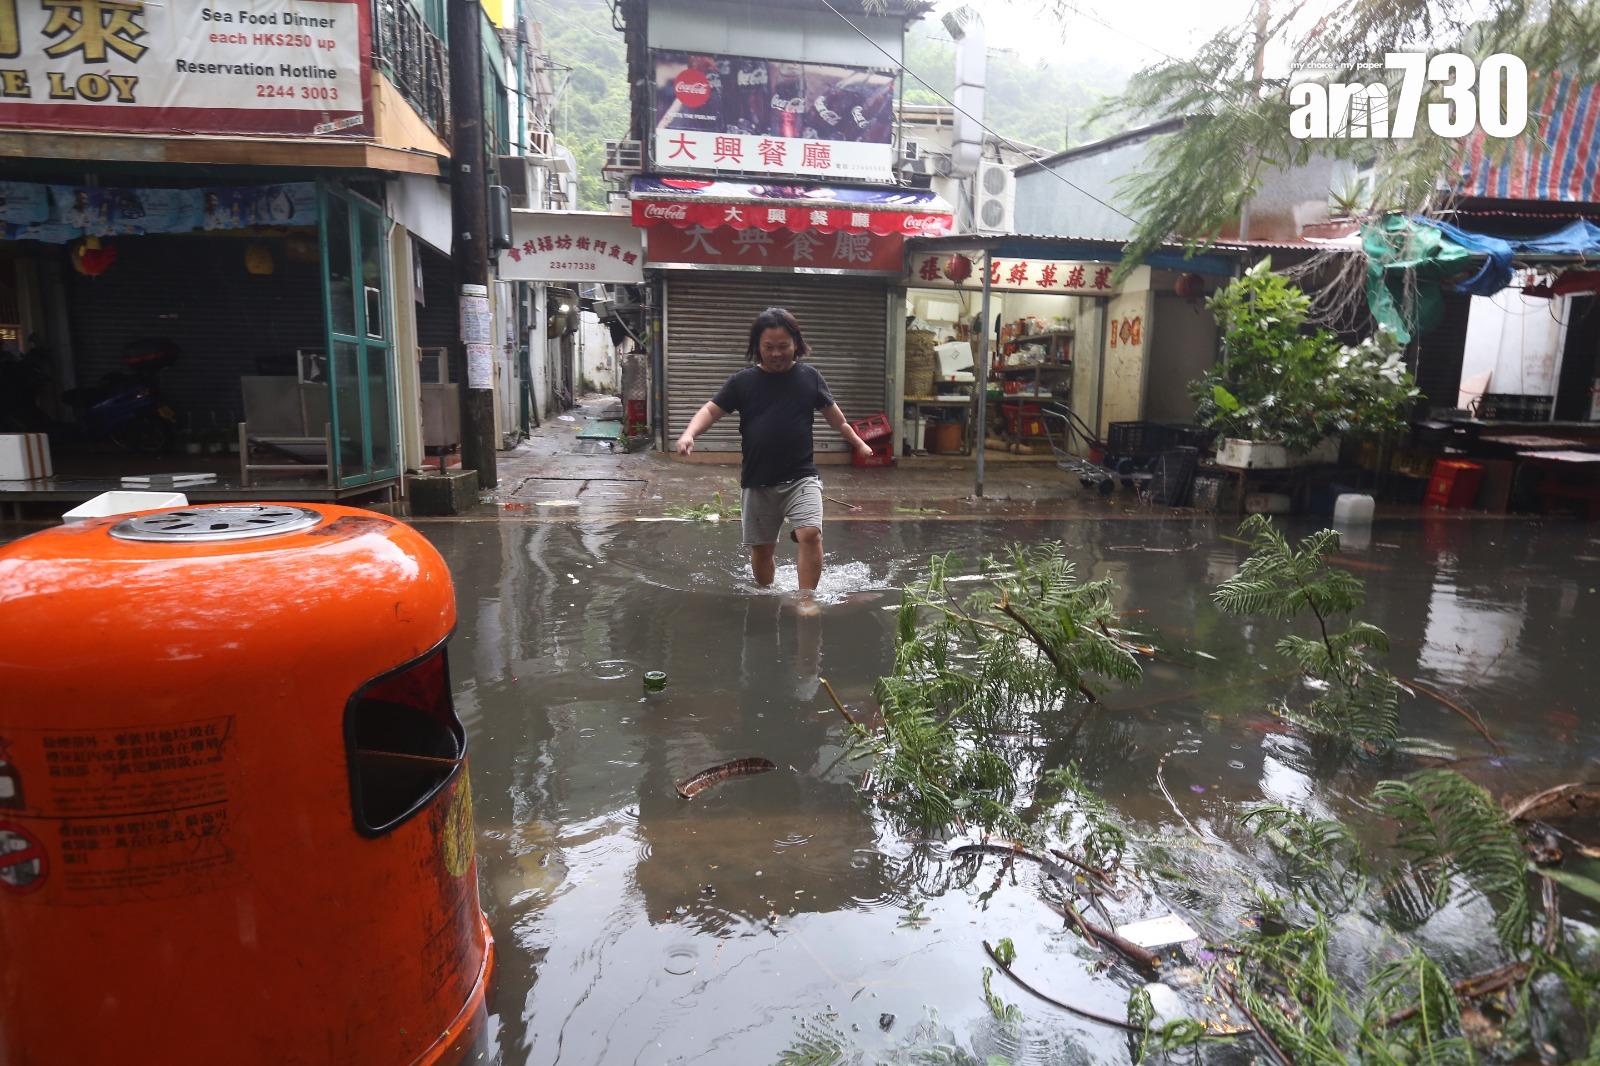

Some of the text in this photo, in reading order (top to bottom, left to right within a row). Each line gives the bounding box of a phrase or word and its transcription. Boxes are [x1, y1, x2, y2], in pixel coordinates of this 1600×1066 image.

[202, 8, 336, 28] Sea Food Dinner
[209, 33, 336, 51] each HK$250 up
[176, 59, 337, 79] Reservation Hotline
[46, 72, 139, 103] LOY
[256, 84, 338, 100] 2244 3003
[668, 133, 831, 169] 大興餐廳
[644, 204, 688, 220] Coca-Cola
[724, 206, 870, 228] 大興餐廳
